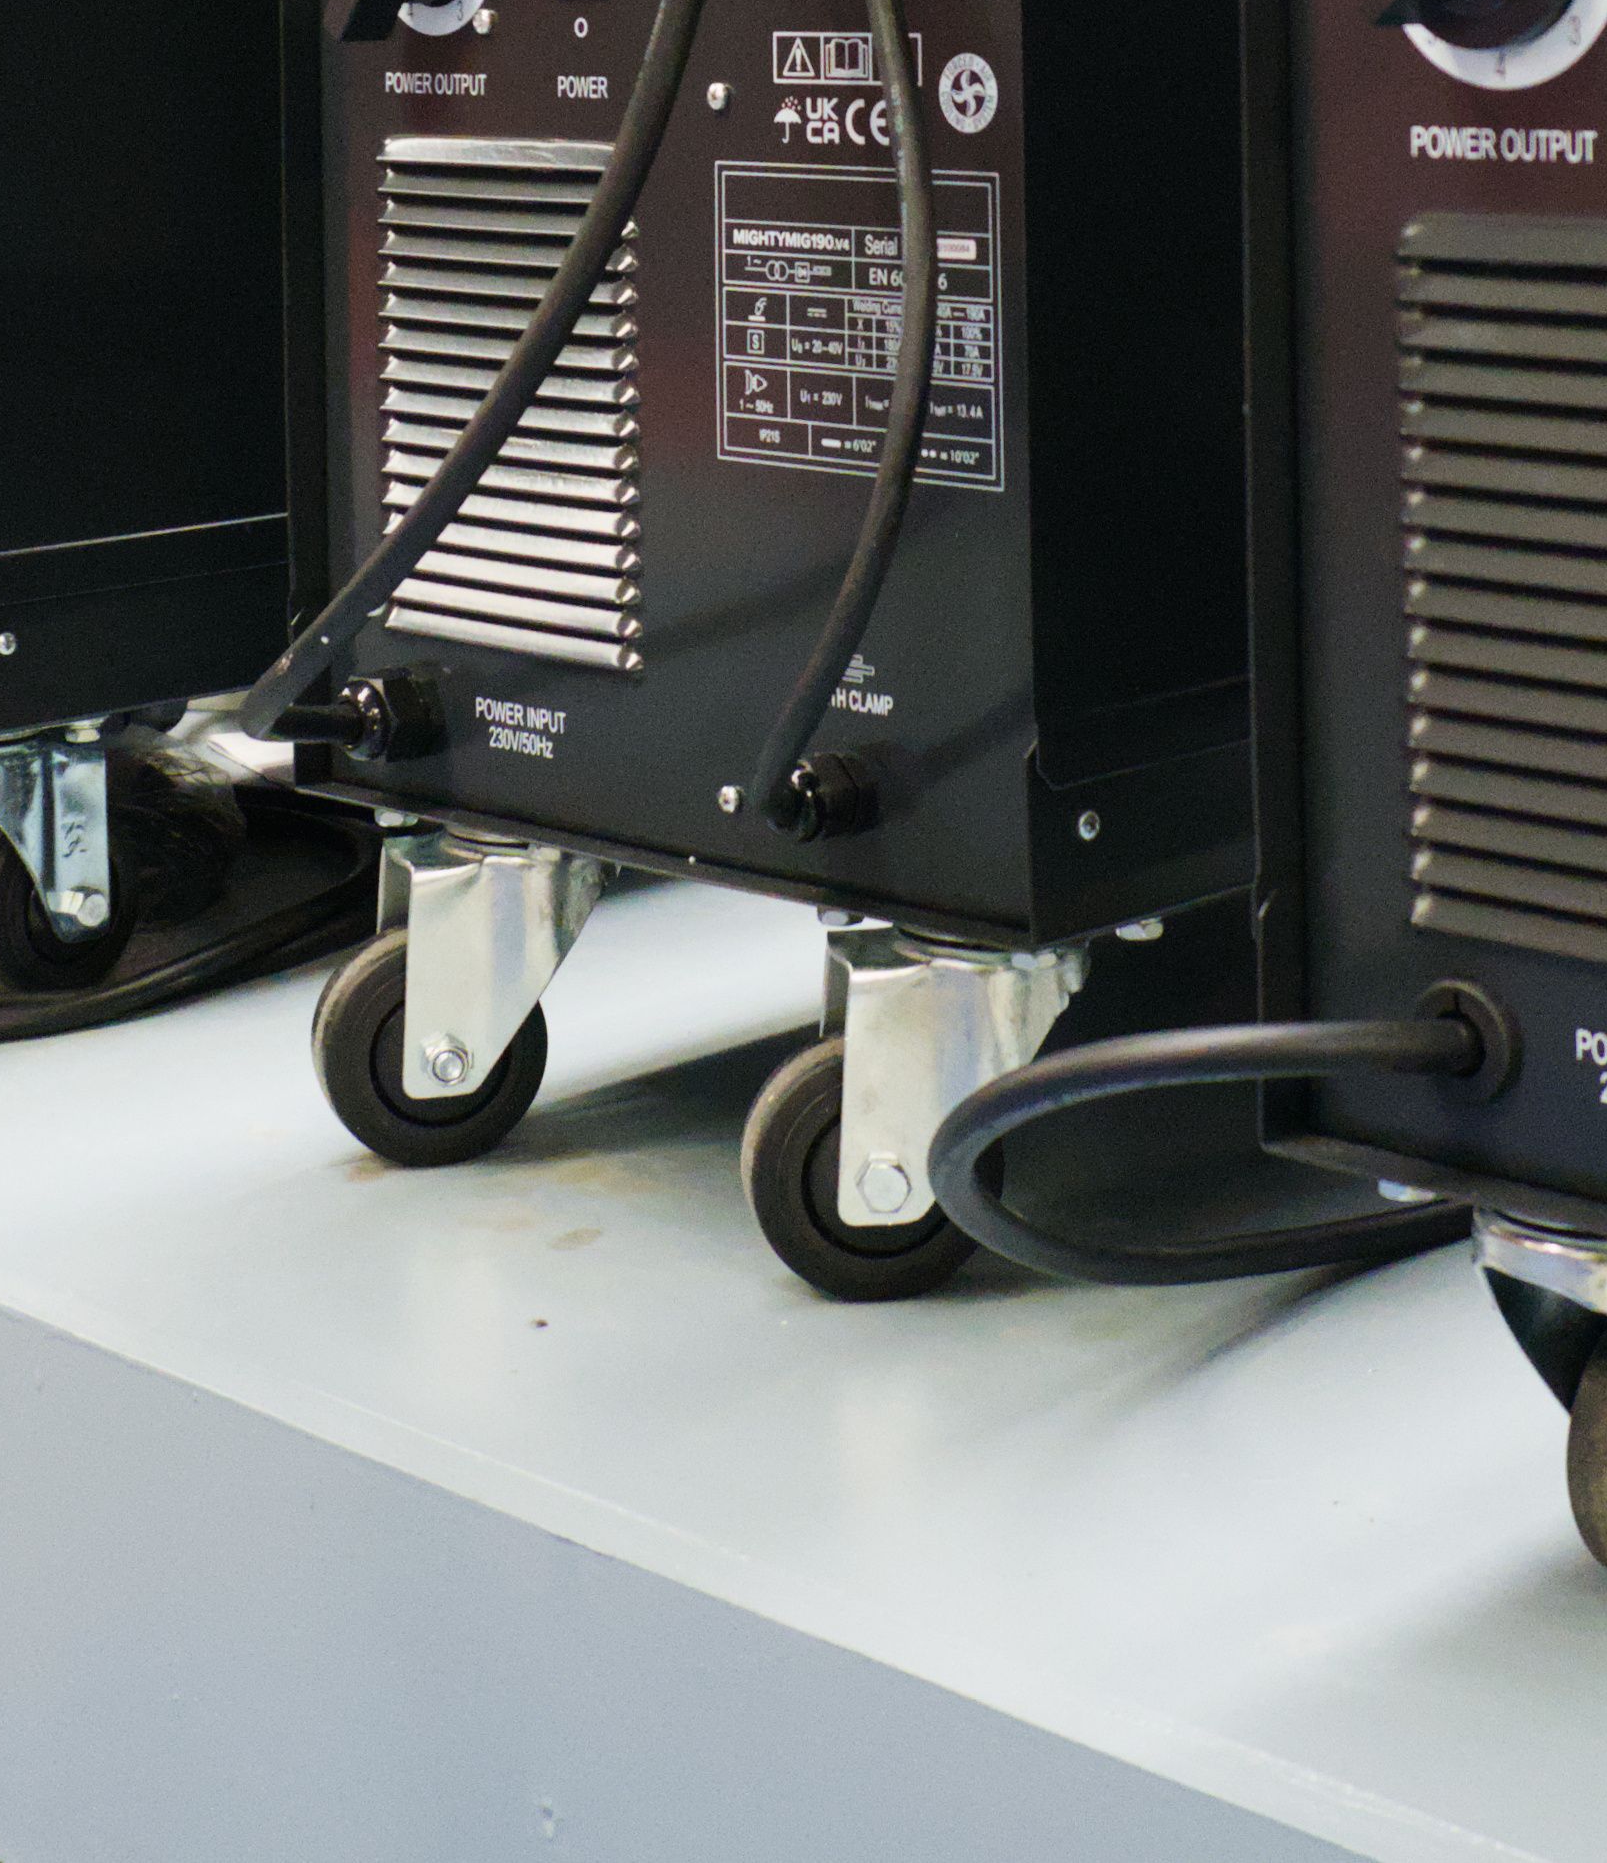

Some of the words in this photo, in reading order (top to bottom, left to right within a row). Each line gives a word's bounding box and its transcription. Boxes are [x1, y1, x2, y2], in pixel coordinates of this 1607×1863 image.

[385, 71, 432, 95] POWER
[434, 73, 487, 96] OUTPUT
[557, 75, 608, 99] POWER
[805, 97, 839, 121] UK
[806, 121, 841, 144] CA
[1410, 125, 1497, 161] POWER
[1500, 127, 1598, 164] OUTPUT
[864, 234, 898, 257] Serial
[869, 267, 888, 286] EN
[852, 297, 881, 315] Welding
[475, 696, 524, 727] POWER
[526, 706, 566, 734] INPUT
[848, 689, 894, 716] CLAMP
[489, 725, 553, 759] 230V/50Hz
